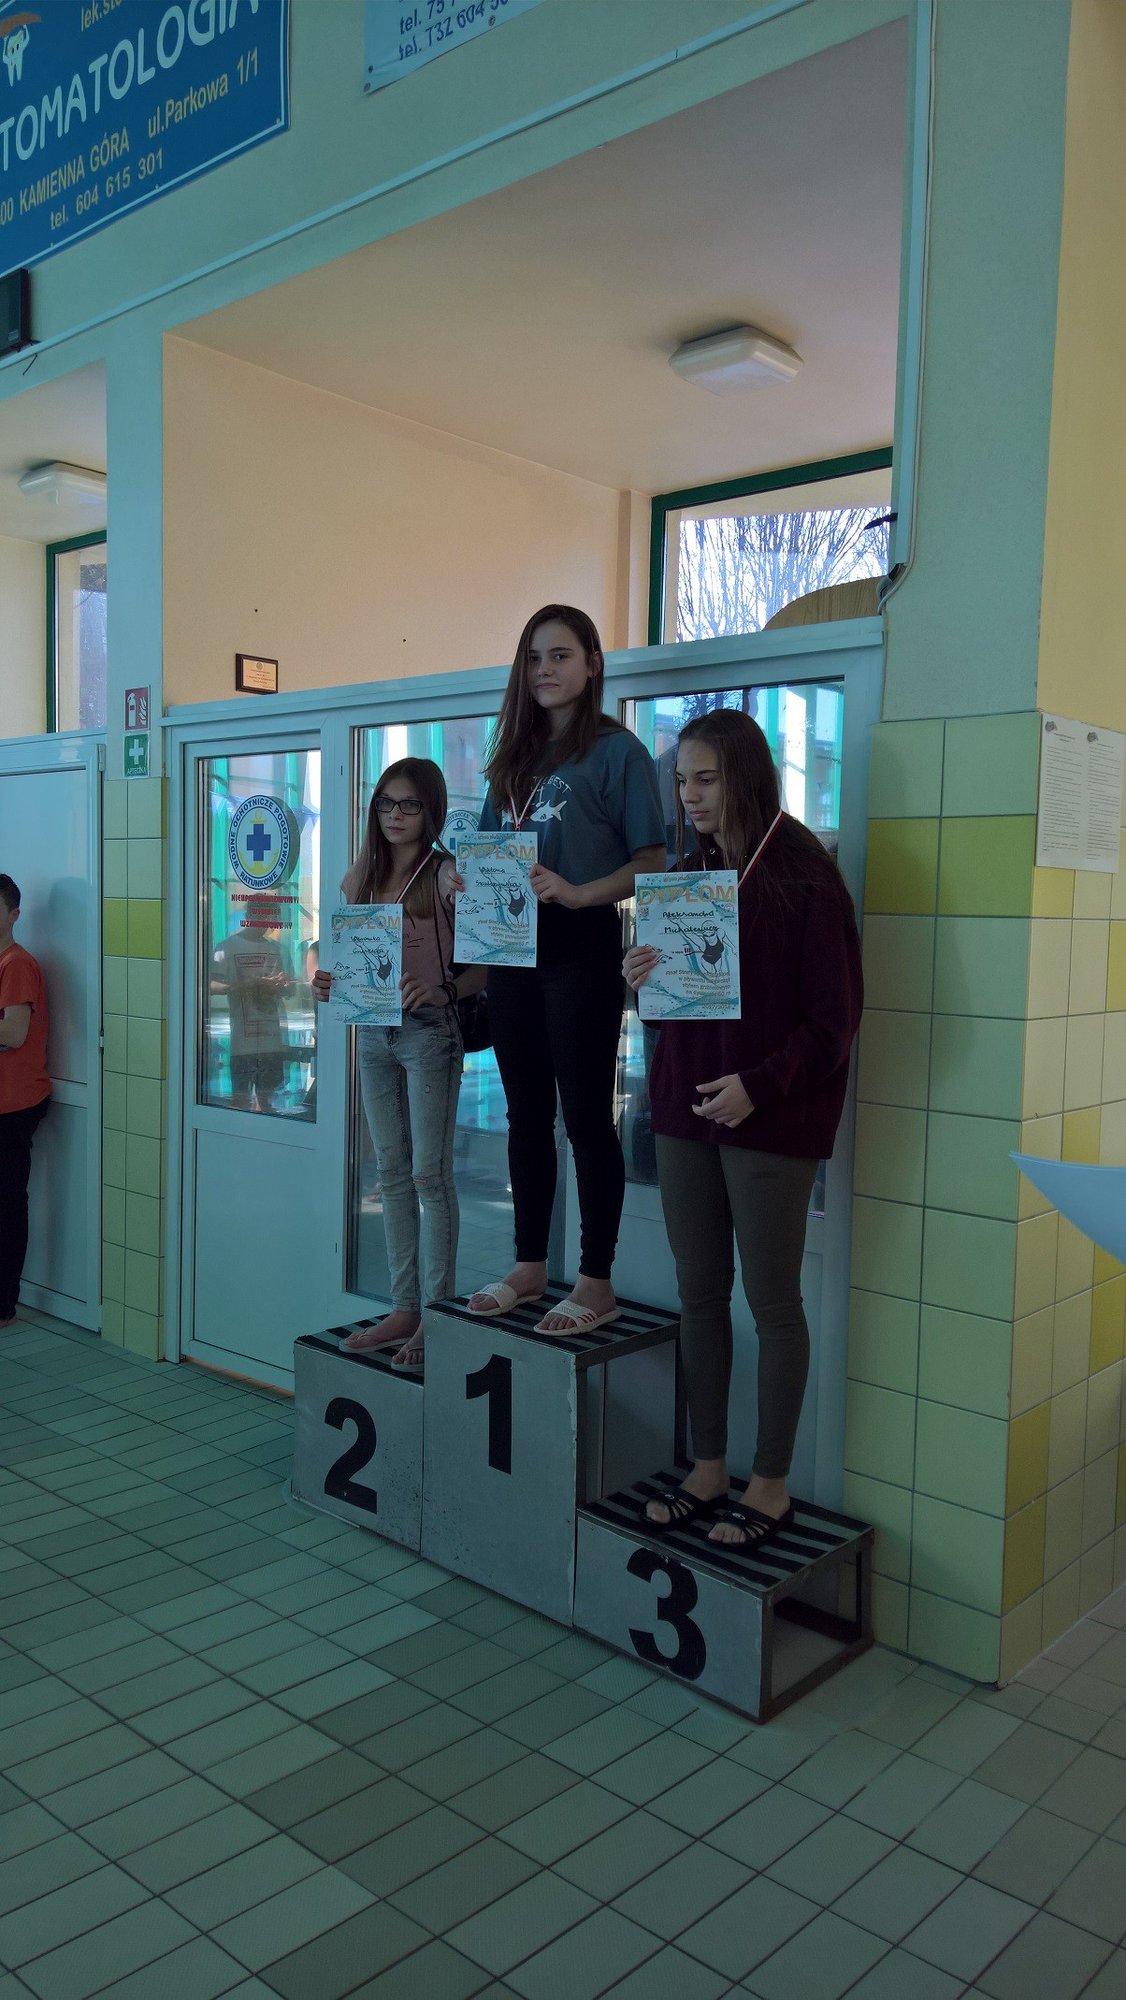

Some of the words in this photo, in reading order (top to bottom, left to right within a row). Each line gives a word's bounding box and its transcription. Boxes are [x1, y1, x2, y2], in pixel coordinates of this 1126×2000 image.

[399, 35, 422, 60] tel.
[457, 0, 485, 29] 604
[400, 8, 422, 35] tel.
[19, 154, 86, 216] KAMIENNA
[90, 126, 131, 173] GÓRA
[148, 72, 229, 139] ul.Parkowa
[236, 47, 259, 85] 1/1
[50, 210, 69, 230] tel.
[75, 188, 99, 215] 604
[105, 172, 131, 198] 615
[137, 147, 164, 180] 301
[234, 797, 273, 828] OCHOTNICZE
[230, 832, 240, 869] WODNE
[274, 806, 289, 869] POGOTOWIE
[458, 843, 536, 861] DYPLOM
[240, 871, 278, 888] RATUNKOWE
[639, 884, 735, 906] DYPLOM
[332, 915, 401, 931] DYPLOM
[465, 1354, 513, 1475] 1
[324, 1396, 378, 1514] 2
[626, 1547, 707, 1682] 3
